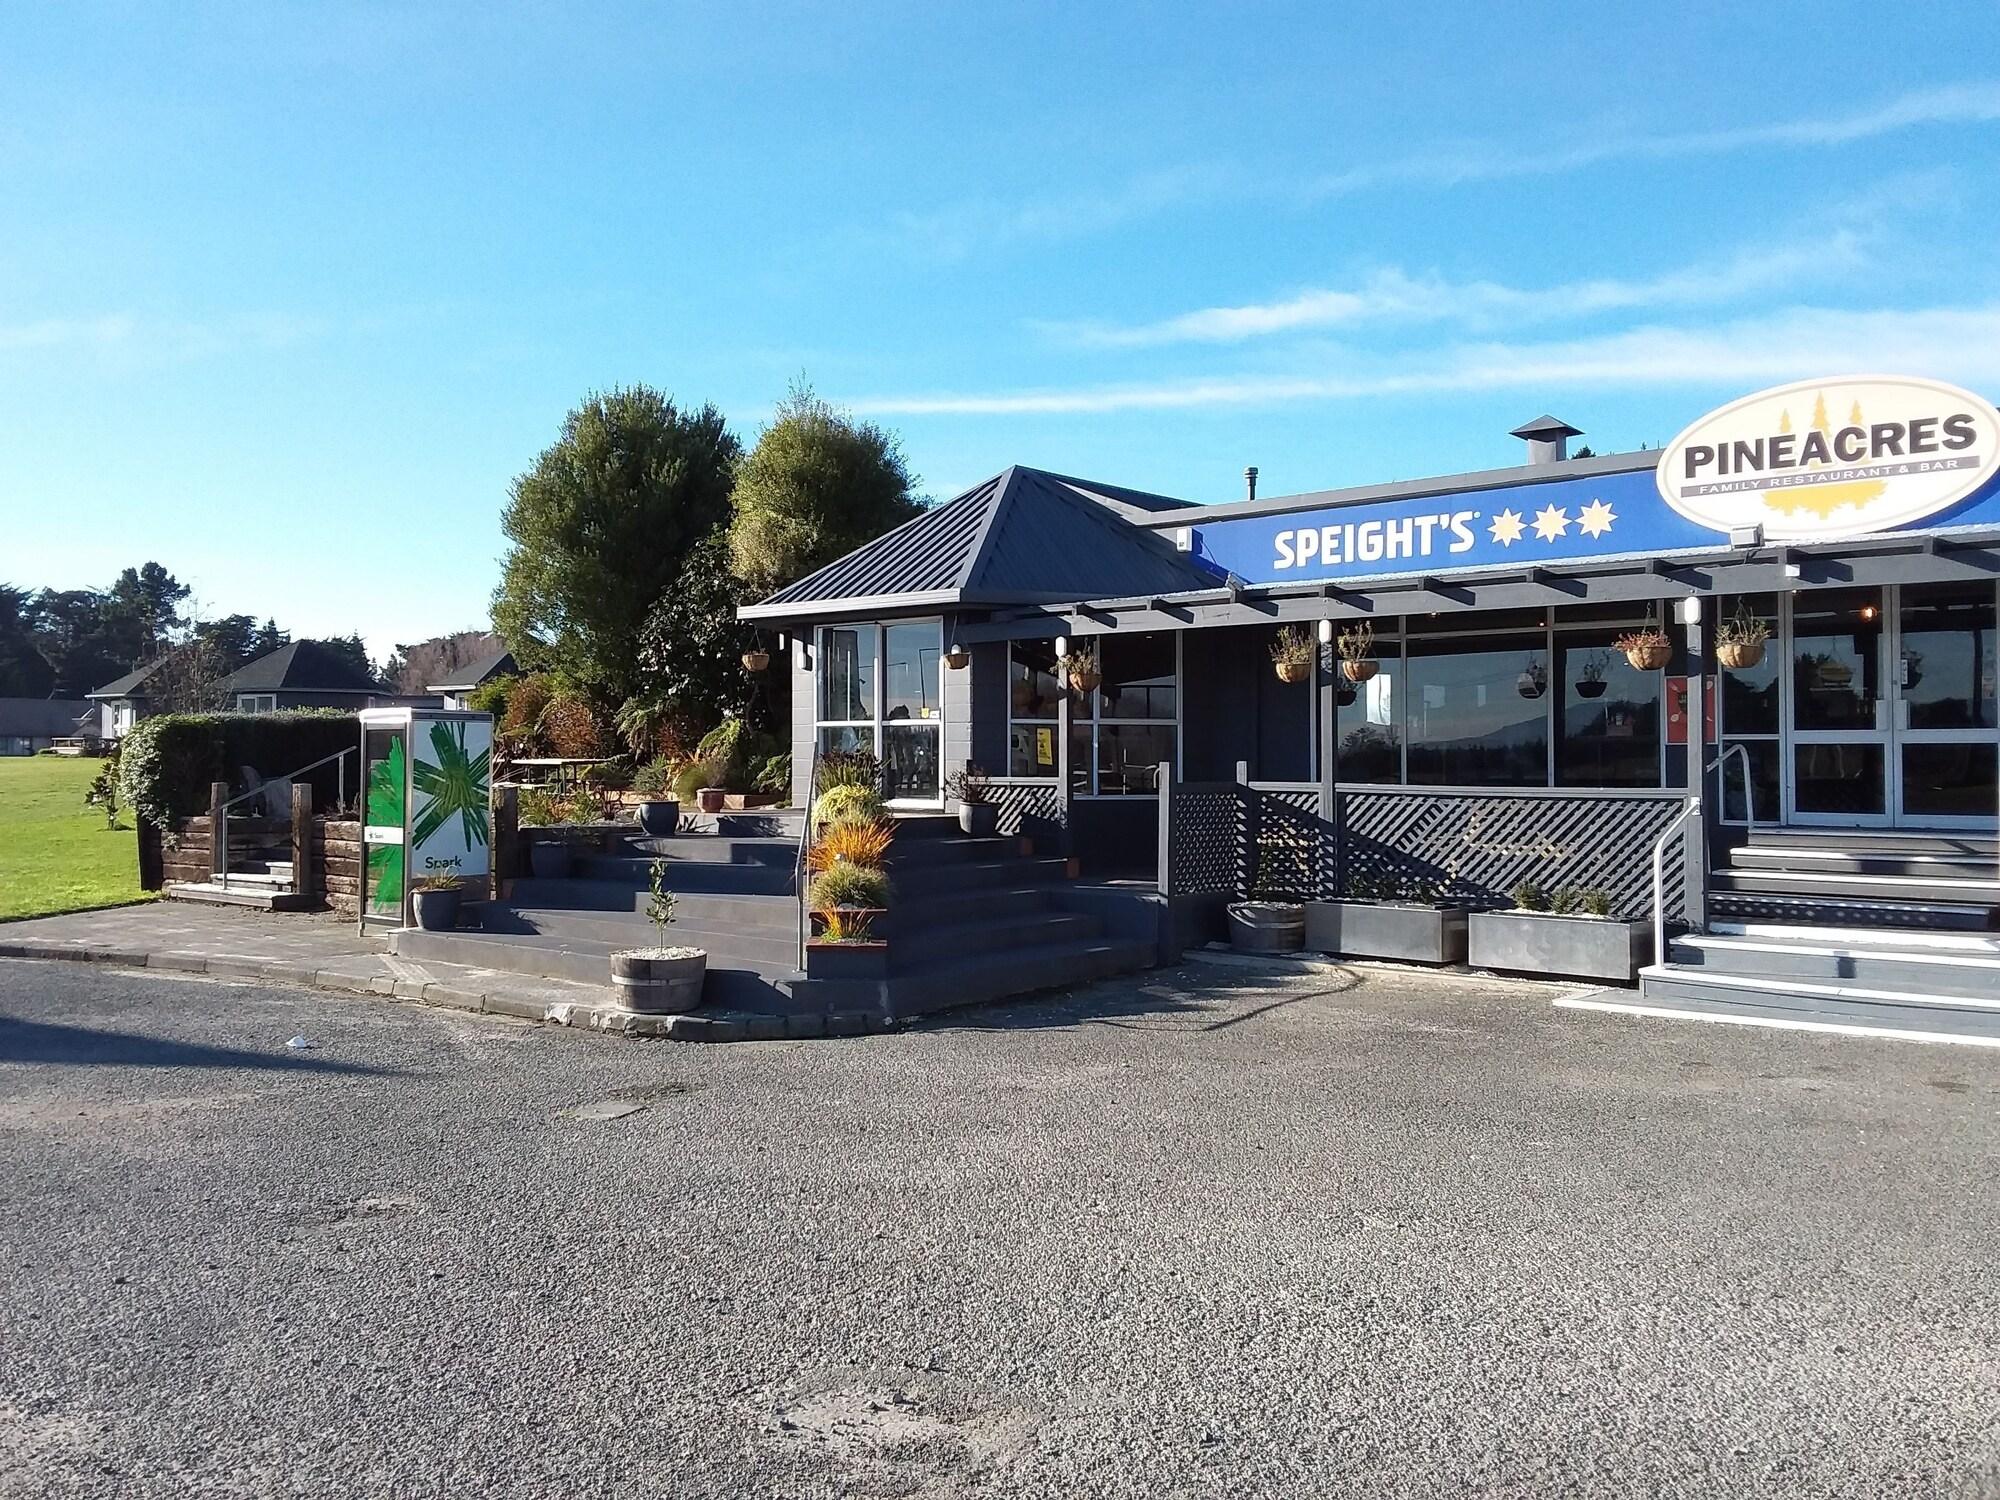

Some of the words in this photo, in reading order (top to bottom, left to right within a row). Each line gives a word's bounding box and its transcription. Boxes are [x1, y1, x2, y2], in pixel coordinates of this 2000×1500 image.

[1684, 413, 1978, 479] PINEACRES
[1699, 479, 1761, 495] FAMILY
[1770, 466, 1892, 488] RESTAURANT
[1899, 463, 1910, 474] &
[1920, 459, 1960, 472] BAR
[1273, 510, 1476, 570] SPEIGHT'S
[424, 855, 463, 871] Spark
